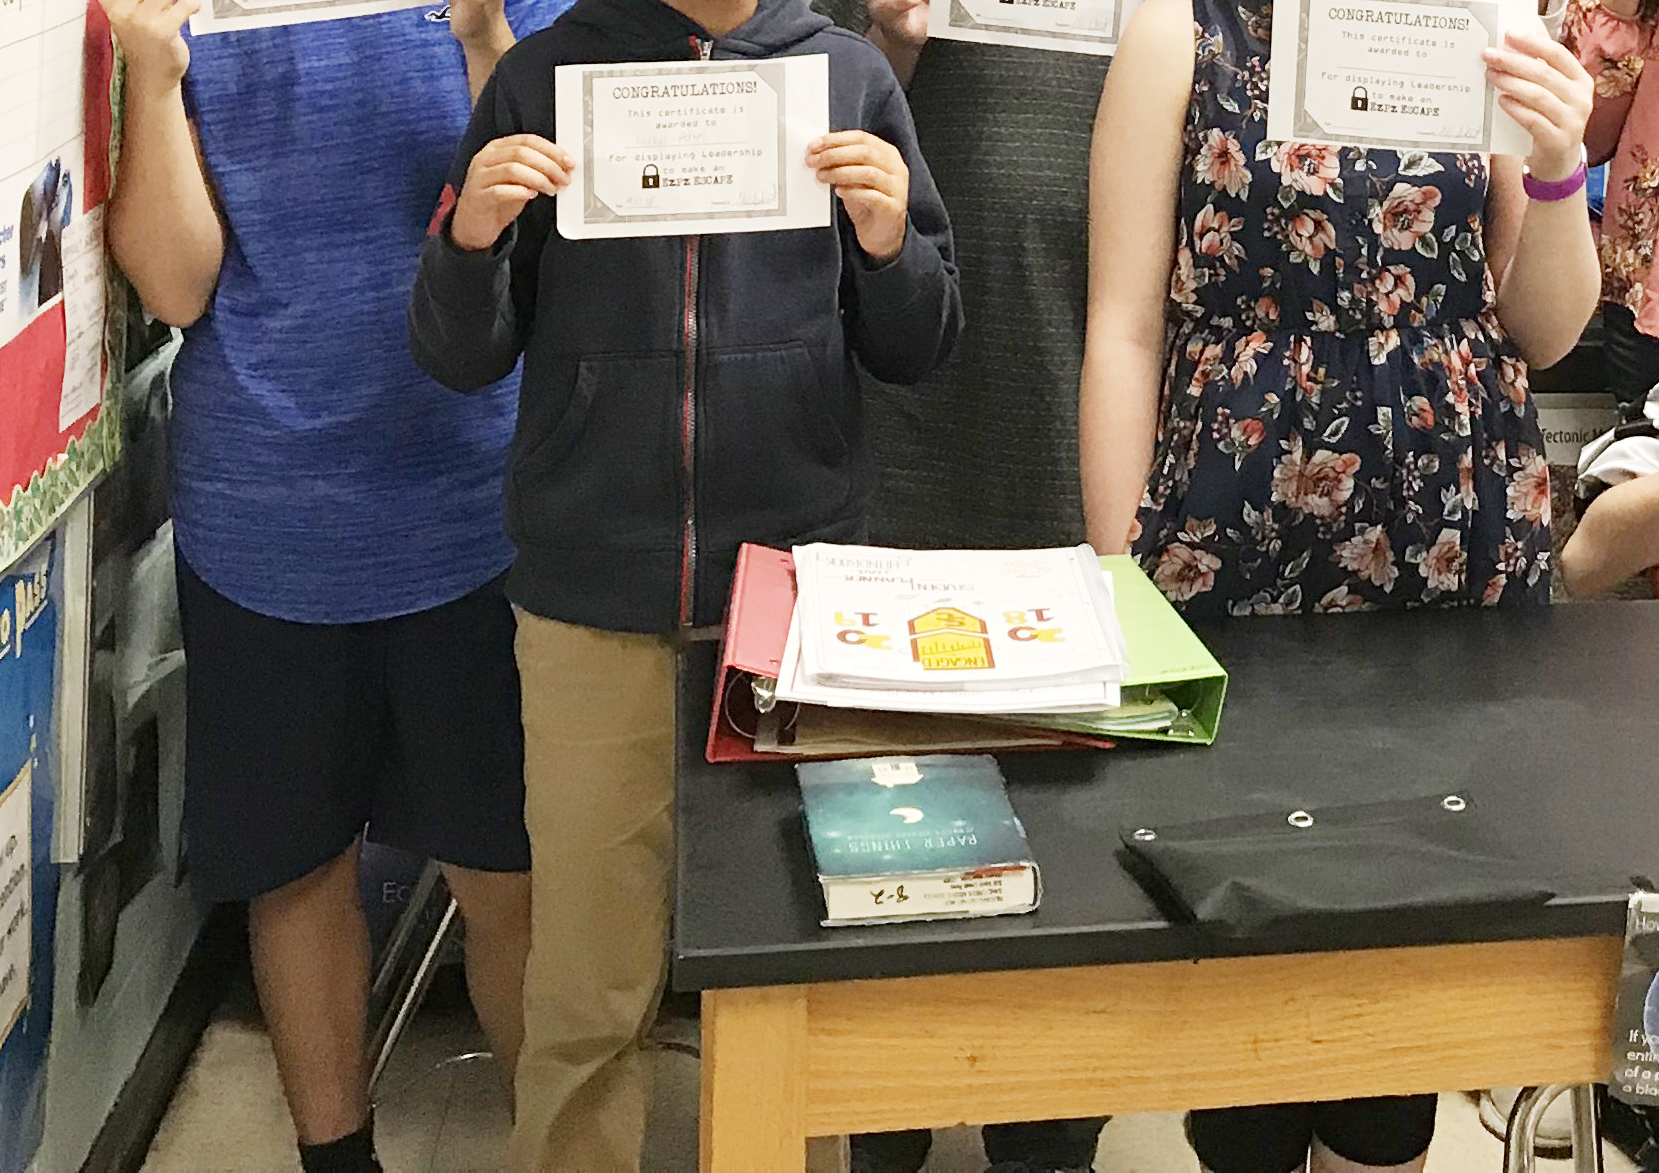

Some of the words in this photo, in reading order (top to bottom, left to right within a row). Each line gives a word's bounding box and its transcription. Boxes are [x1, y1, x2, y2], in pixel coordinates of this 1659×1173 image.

[1328, 7, 1470, 31] CONGRATULATIONS!
[1341, 31, 1365, 41] This
[1371, 33, 1437, 48] certificate
[1444, 40, 1456, 49] is
[1367, 46, 1410, 57] awarded
[1416, 49, 1428, 59] to
[612, 81, 758, 100] CONGRATULATIONS!
[1321, 71, 1340, 82] For
[1345, 73, 1405, 89] displaying
[1411, 79, 1472, 94] Leadership
[1372, 91, 1384, 101] to
[1389, 93, 1415, 103] make
[1420, 96, 1432, 105] an
[627, 109, 651, 118] This
[658, 106, 726, 117] certificate
[733, 105, 744, 114] is
[1370, 102, 1398, 114] EzPz
[1401, 105, 1440, 117] ESCAPE
[656, 119, 699, 129] awarded
[705, 118, 717, 128] to
[609, 153, 628, 163] For
[634, 150, 696, 165] displaying
[701, 147, 764, 160] Leadership
[663, 166, 675, 175] to
[680, 164, 706, 175] make
[713, 164, 725, 173] an
[662, 176, 691, 188] EzPz
[693, 174, 733, 186] ESCAPE
[1542, 427, 1590, 444] Tectonic
[844, 574, 914, 590] PLANNER
[1002, 607, 1056, 625] 18
[836, 628, 893, 650] 20
[1007, 625, 1067, 643] 20
[848, 836, 912, 854] THINGS
[922, 833, 979, 849] PAPER
[869, 883, 911, 906] 8-2
[1629, 1029, 1639, 1043] If
[1624, 1065, 1639, 1079] of
[1641, 1069, 1652, 1081] a
[1622, 1083, 1633, 1094] a
